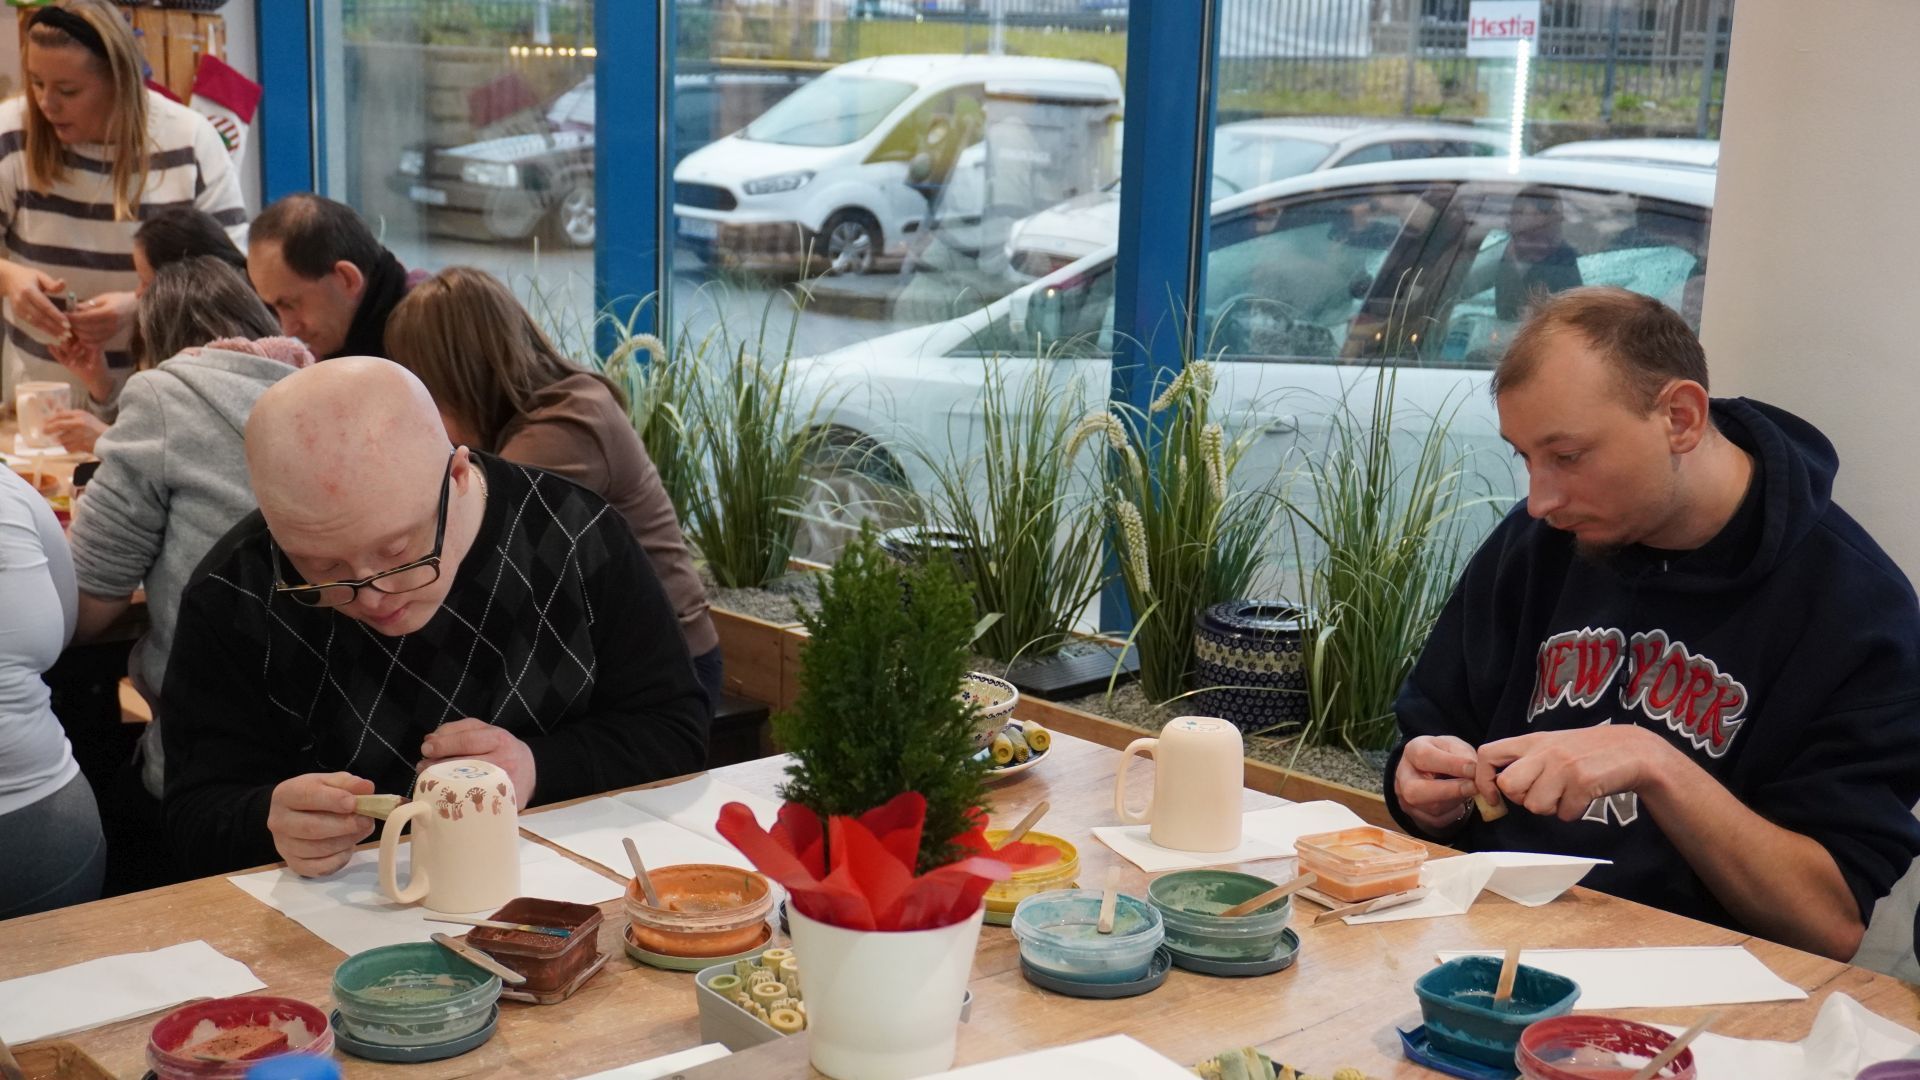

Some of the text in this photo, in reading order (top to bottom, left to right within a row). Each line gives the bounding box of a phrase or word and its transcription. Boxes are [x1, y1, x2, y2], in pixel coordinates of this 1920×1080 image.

[1471, 14, 1535, 36] Hestia
[1533, 636, 1742, 749] NEW YORK
